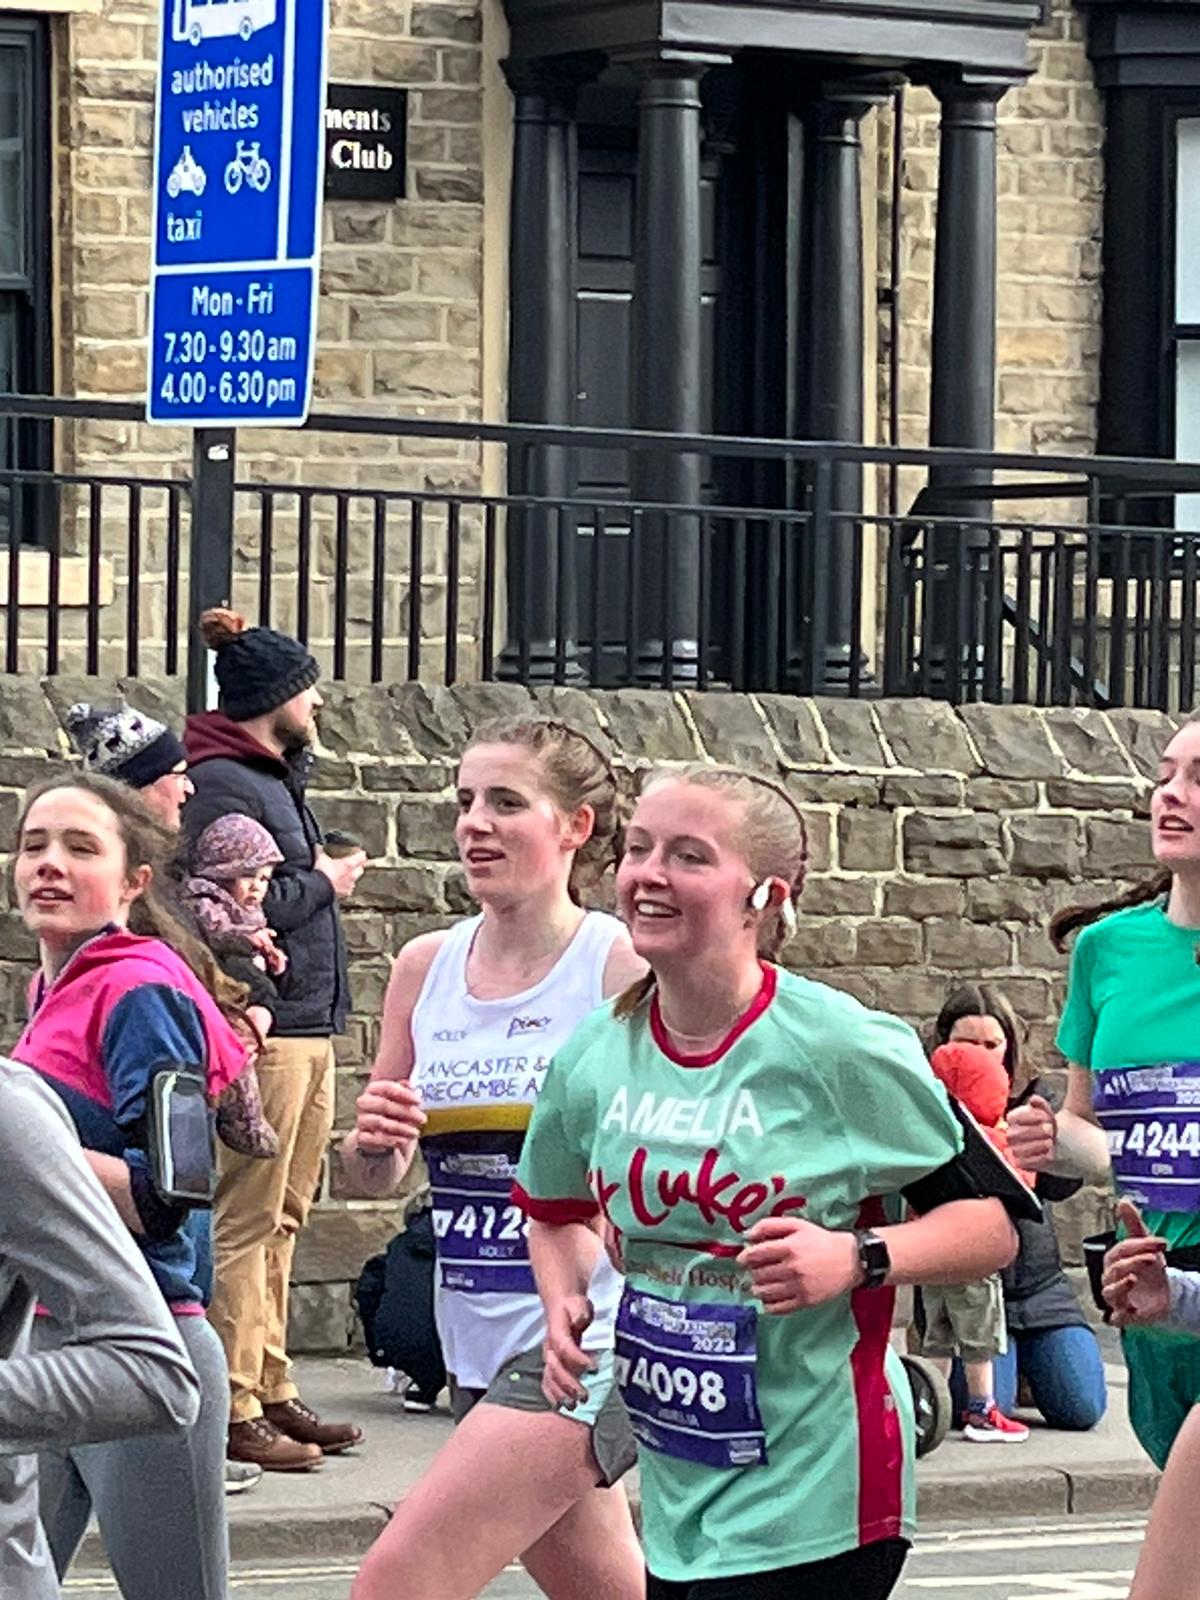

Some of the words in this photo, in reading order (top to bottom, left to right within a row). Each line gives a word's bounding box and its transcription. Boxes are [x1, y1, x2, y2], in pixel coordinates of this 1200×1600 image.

[171, 54, 273, 95] authorised
[182, 98, 259, 133] vehicles
[331, 139, 392, 170] Club
[167, 211, 202, 243] taxi
[533, 1056, 549, 1072] &
[602, 1084, 764, 1146] AMELIA
[1126, 1121, 1200, 1158] 4244
[631, 1356, 728, 1413] 4098
